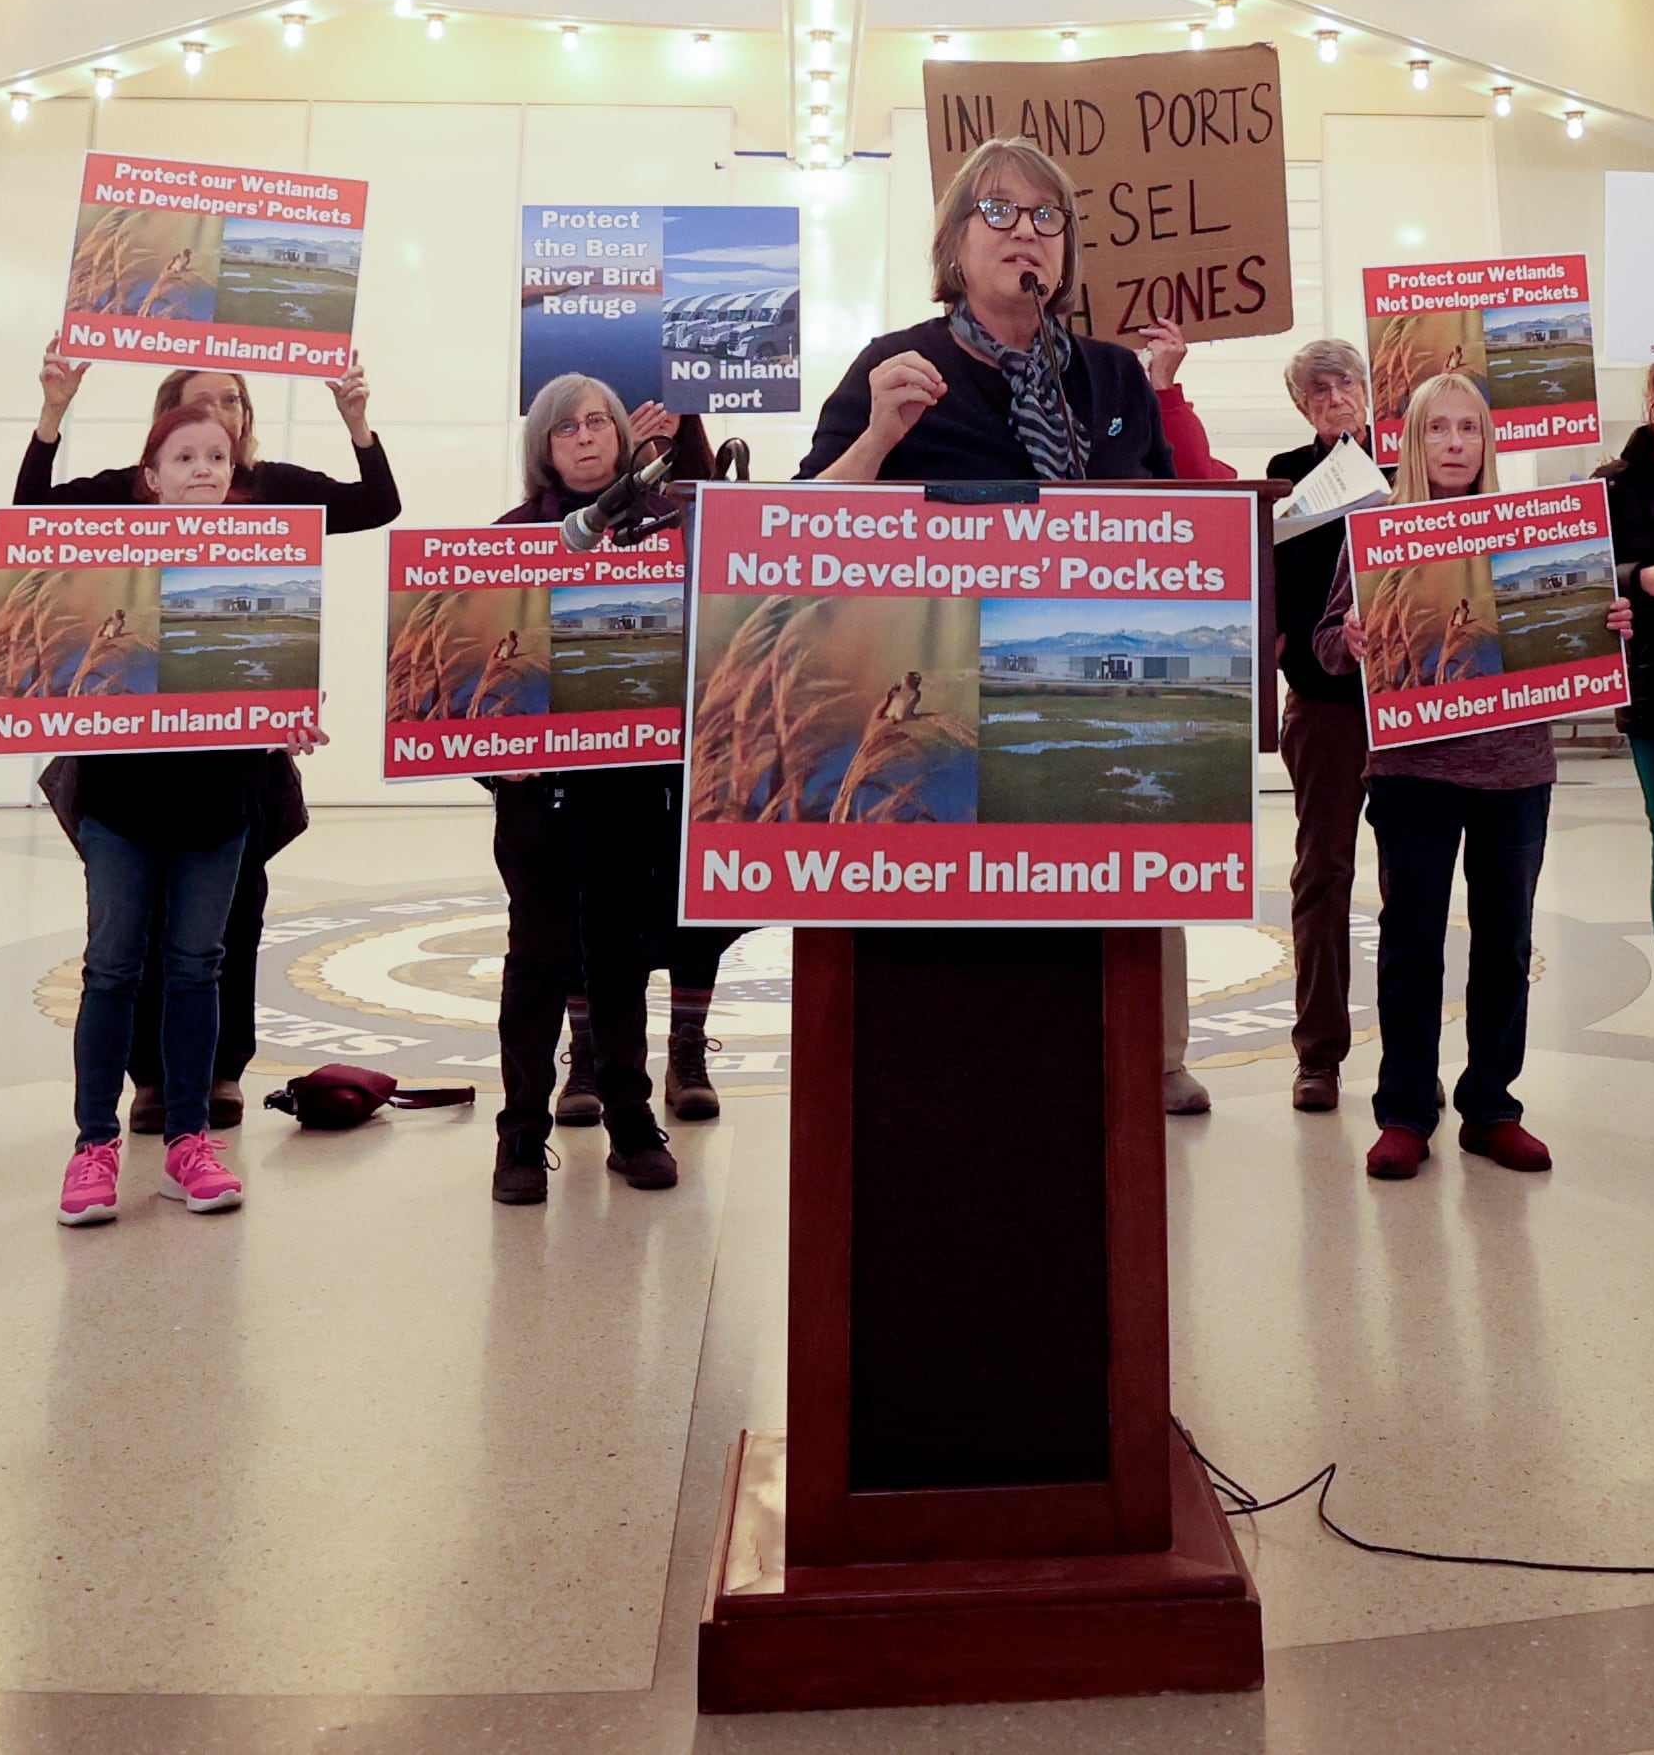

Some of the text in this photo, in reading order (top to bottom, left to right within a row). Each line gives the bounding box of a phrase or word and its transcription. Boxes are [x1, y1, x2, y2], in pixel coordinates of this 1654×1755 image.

[1136, 83, 1273, 153] PORTS
[114, 162, 339, 201] Protect our Wetlands
[95, 184, 352, 225] Not Developers' Pockets
[542, 210, 640, 229] Protect
[533, 239, 648, 257] the Bear
[525, 267, 656, 286] River Bird
[1387, 263, 1565, 289] Protect our Wetlands
[543, 296, 637, 319] Refuge
[1115, 255, 1266, 336] ZONES
[1376, 284, 1578, 312] Not Developers' Pockets
[69, 324, 346, 367] No Weber Inland Port
[671, 361, 799, 380] NO inland
[708, 389, 763, 412] port
[1381, 413, 1596, 452] N nland Port
[28, 516, 290, 536] Protect our Wetlands
[761, 505, 1194, 543] Protect our Wetlands
[1379, 494, 1582, 537] Protect our Wetlands
[7, 543, 307, 566] Not Developers' Pockets
[424, 537, 515, 557] Protect
[520, 539, 558, 555] our
[1366, 519, 1597, 566] Not Developers' Pockets
[405, 561, 685, 586] Not Developers' Pockets
[728, 553, 1225, 595] Not Developers' Pockets
[1377, 669, 1622, 730] No Weber Inland Port
[39, 712, 145, 735] Weber
[151, 707, 242, 733] Inland
[248, 705, 314, 729] Port
[393, 724, 681, 762] No Weber Inland Por
[702, 850, 1245, 893] No Weber Inland Port
